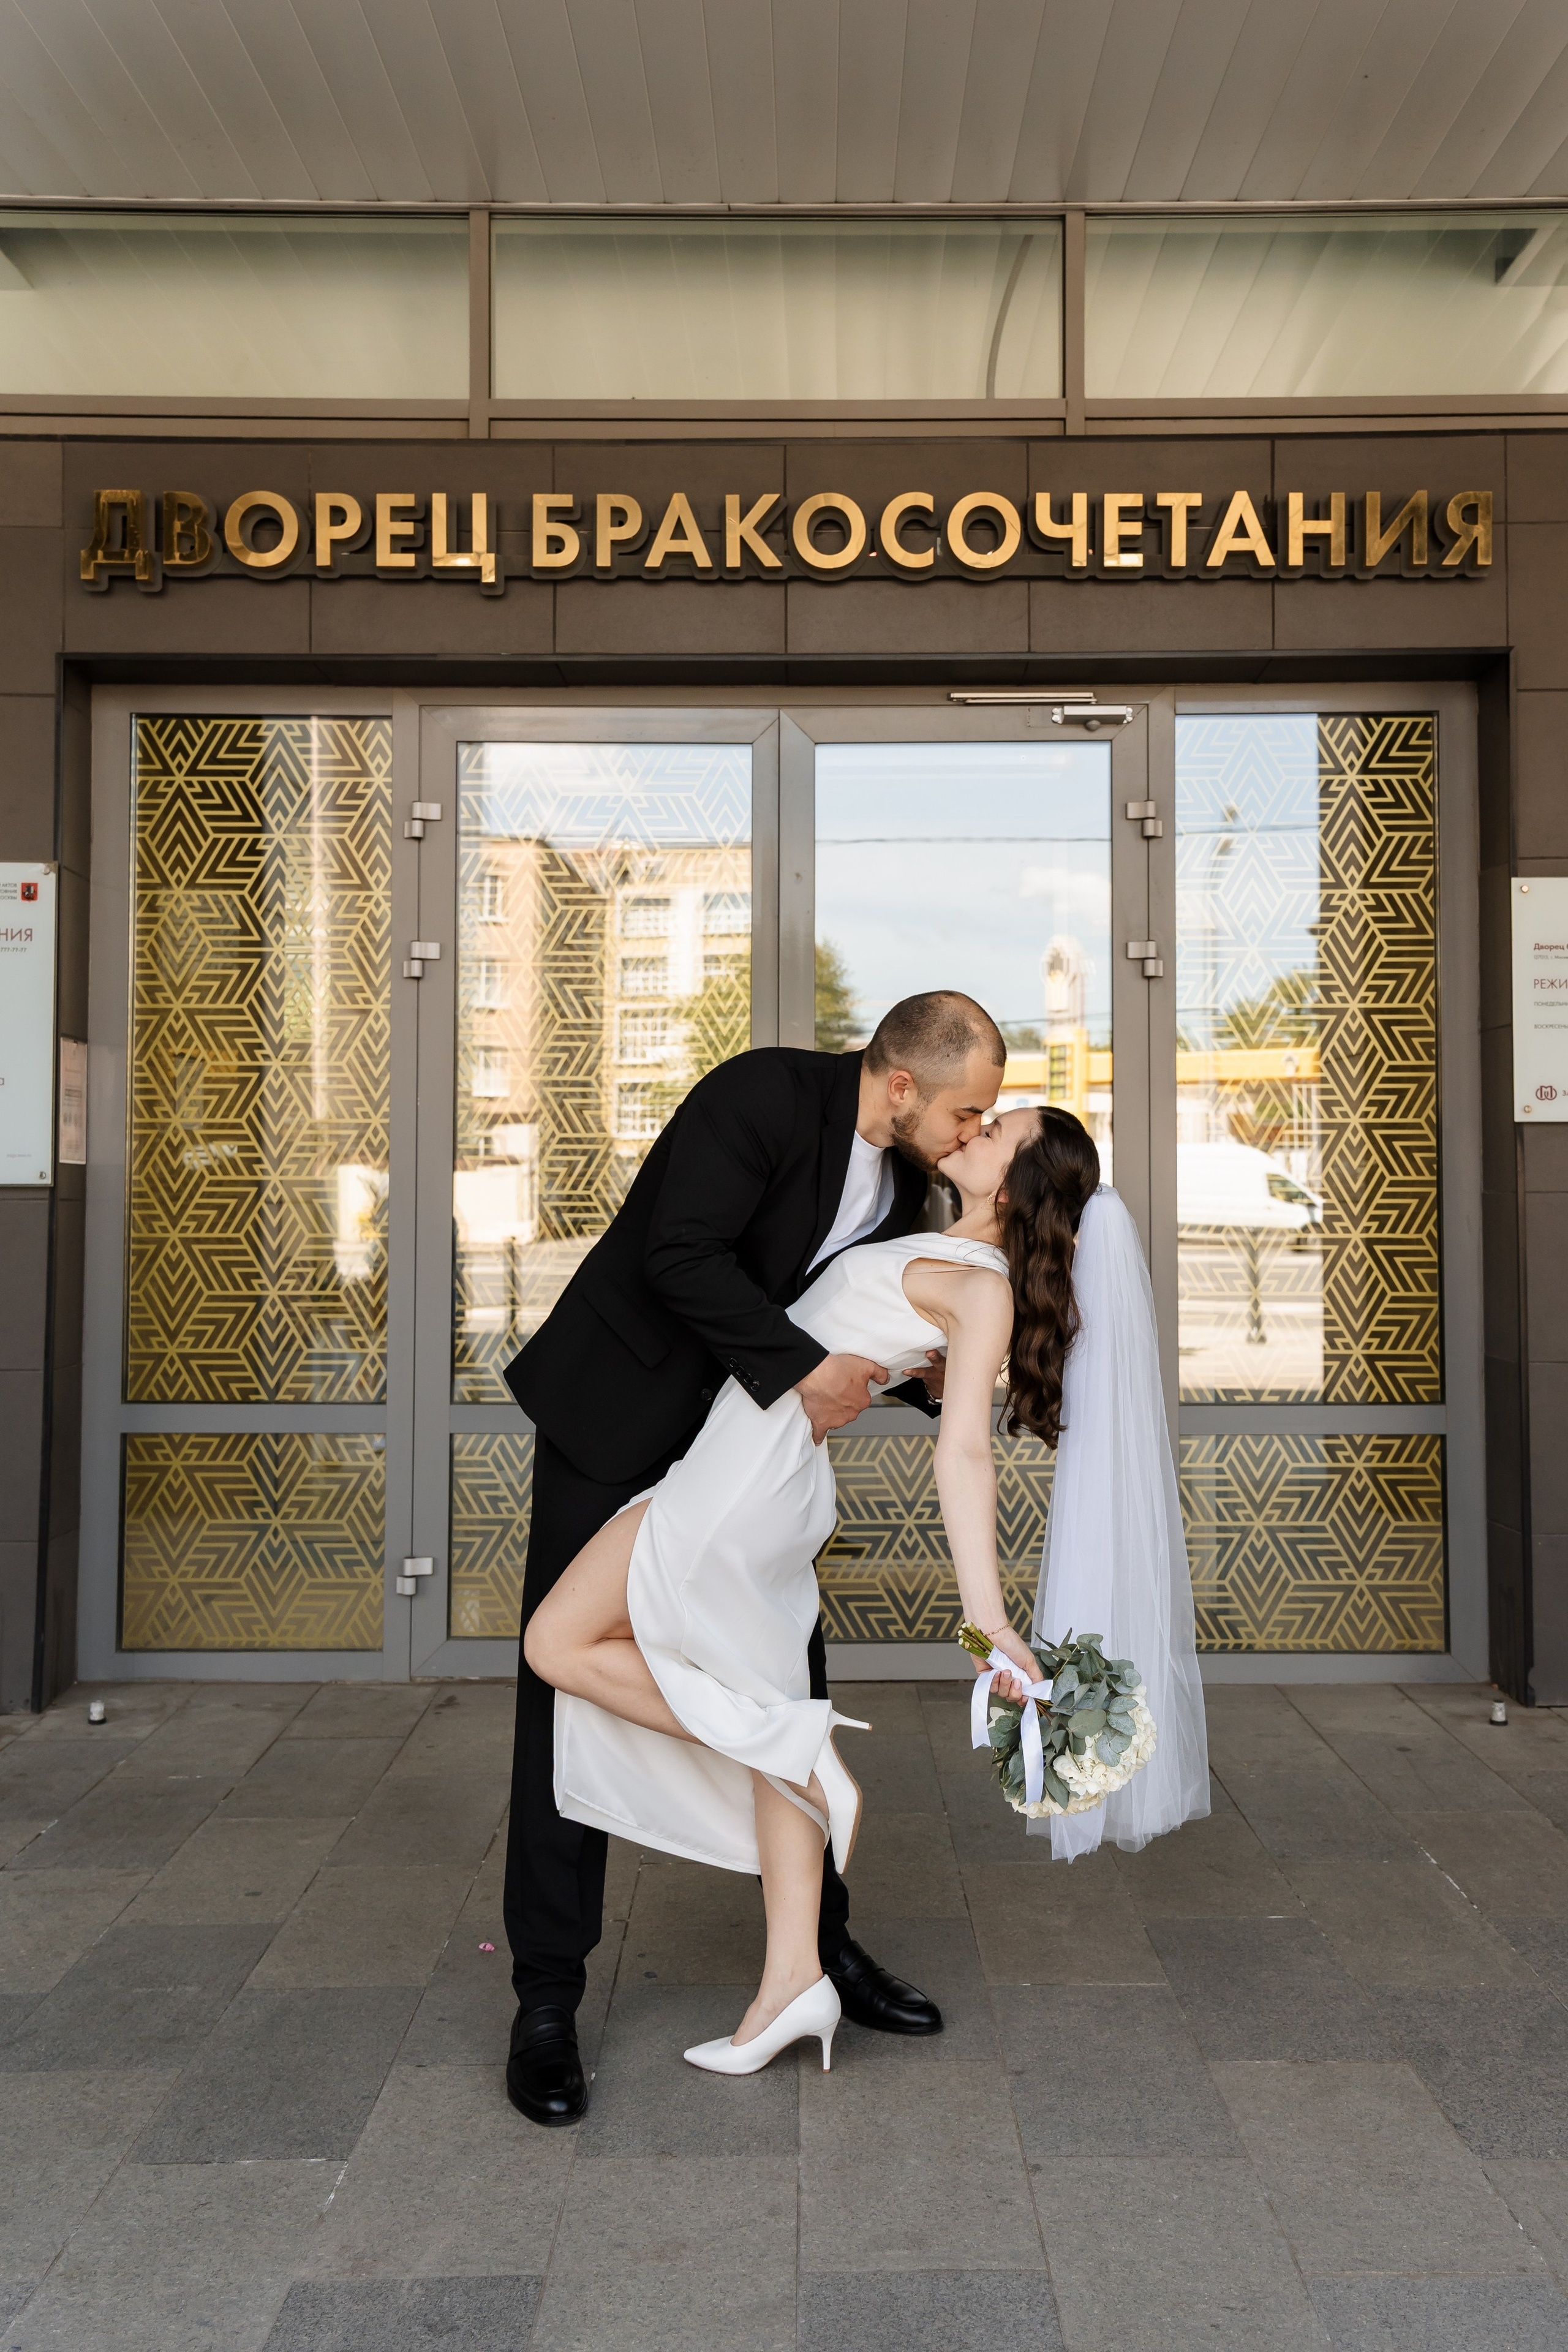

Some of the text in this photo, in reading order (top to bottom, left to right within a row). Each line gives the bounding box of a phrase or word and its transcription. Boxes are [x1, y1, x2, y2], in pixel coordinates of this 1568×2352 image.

[80, 489, 1493, 582] ДВОРЕЦ БРАКОСОЧЕТАНИЯ
[0, 928, 32, 941] НИЯ
[1533, 943, 1564, 952] Дворец
[1534, 979, 1567, 989] РЕЖИ
